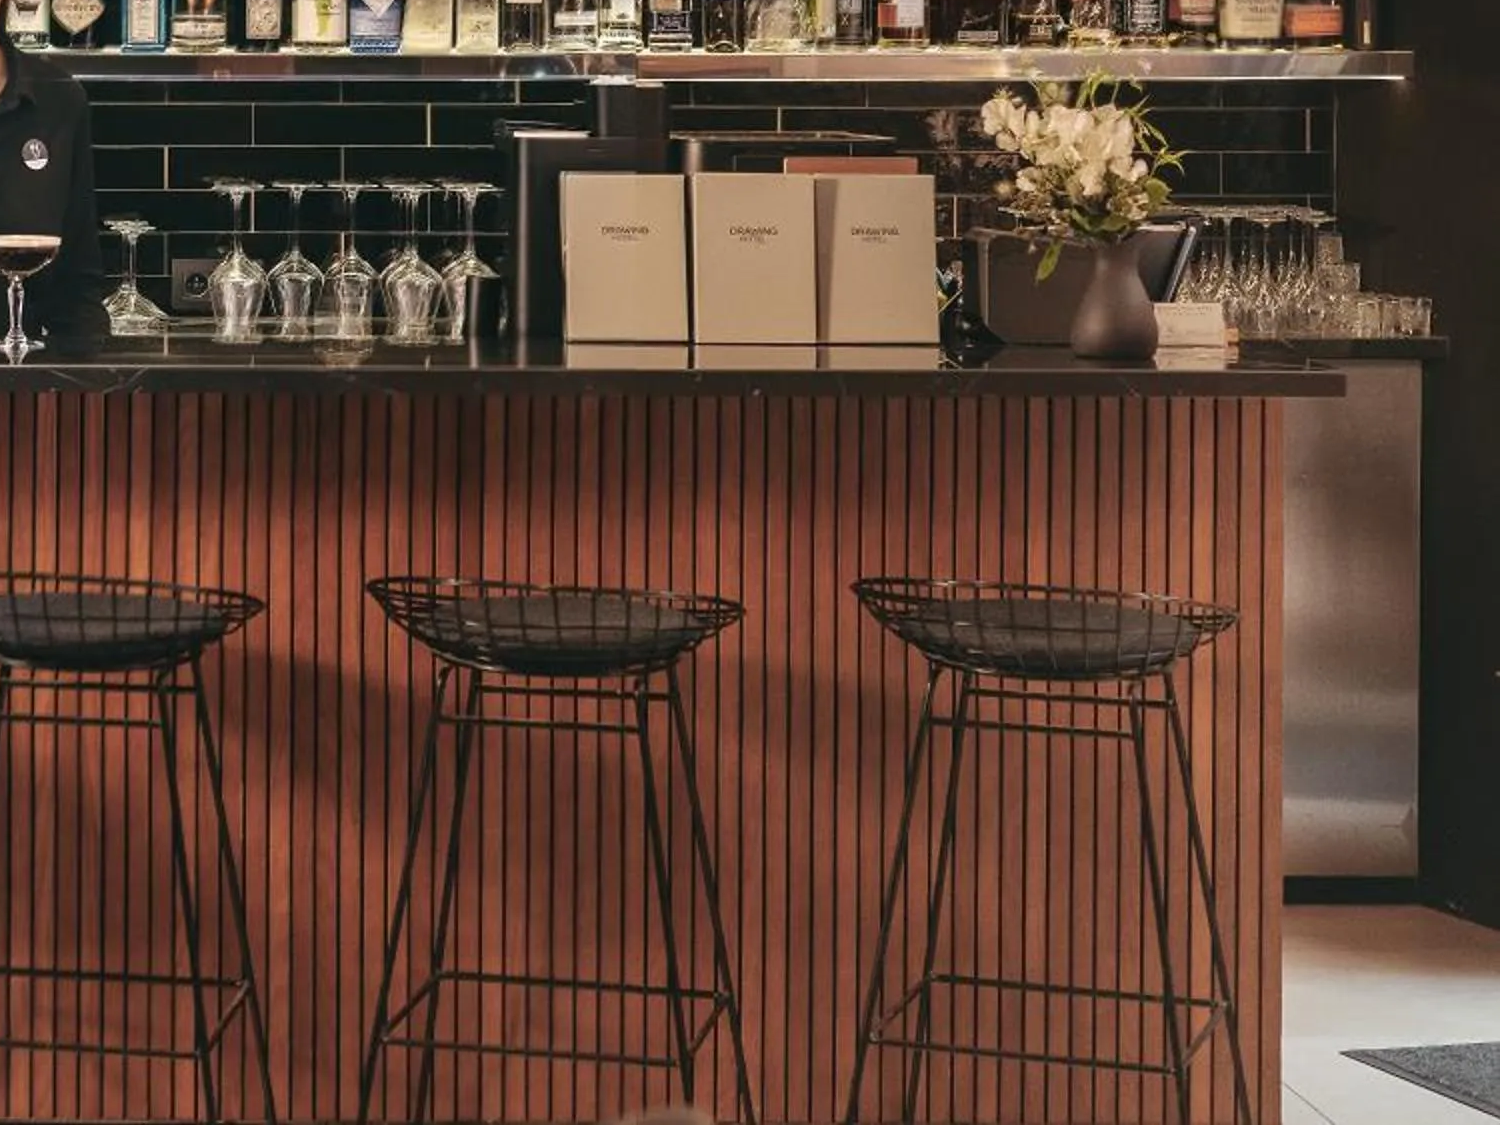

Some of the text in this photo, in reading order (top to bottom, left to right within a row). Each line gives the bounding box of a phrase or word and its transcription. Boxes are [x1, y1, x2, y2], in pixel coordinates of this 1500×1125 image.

[601, 226, 650, 235] DRAWING
[728, 226, 779, 235] DRAWING
[851, 226, 900, 235] DRAWING
